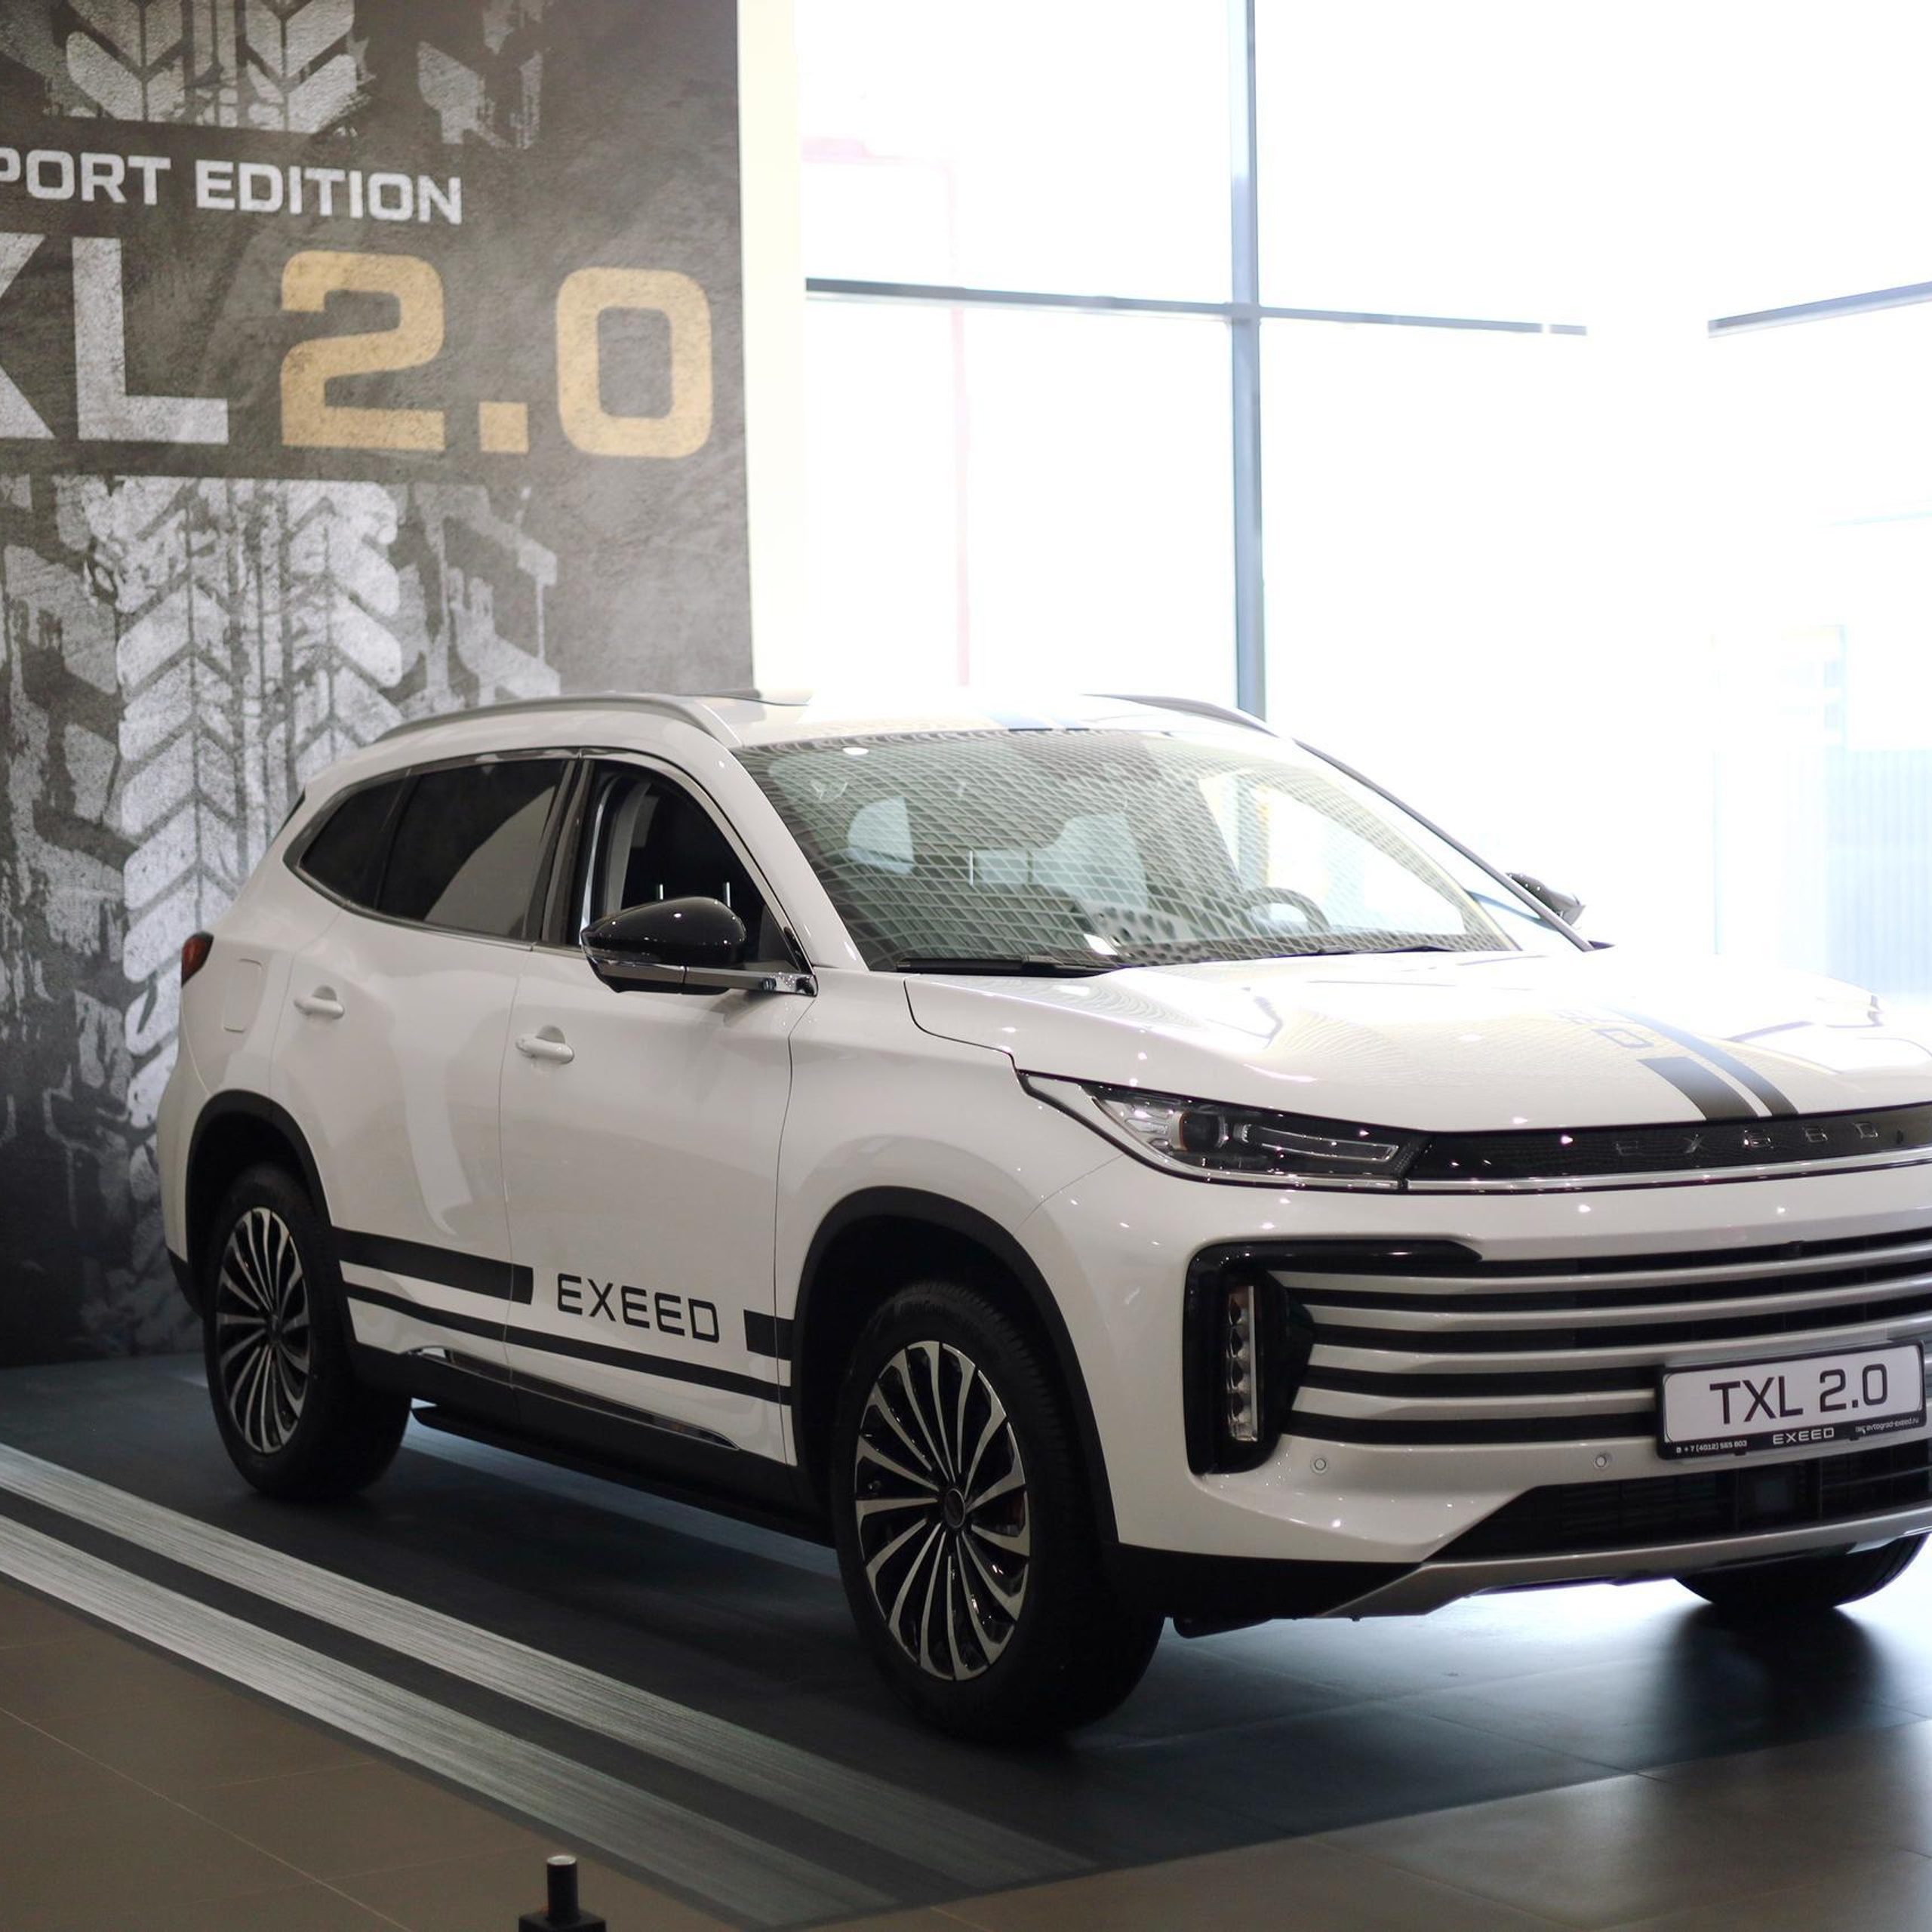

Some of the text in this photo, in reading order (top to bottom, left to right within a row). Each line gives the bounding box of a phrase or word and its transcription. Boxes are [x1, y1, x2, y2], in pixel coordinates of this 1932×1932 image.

[195, 159, 462, 224] EDITION
[281, 251, 713, 457] 2.0
[557, 1272, 720, 1343] EXEED
[1709, 1363, 1888, 1425] TXL 2.0
[1773, 1428, 1835, 1444] EXEED
